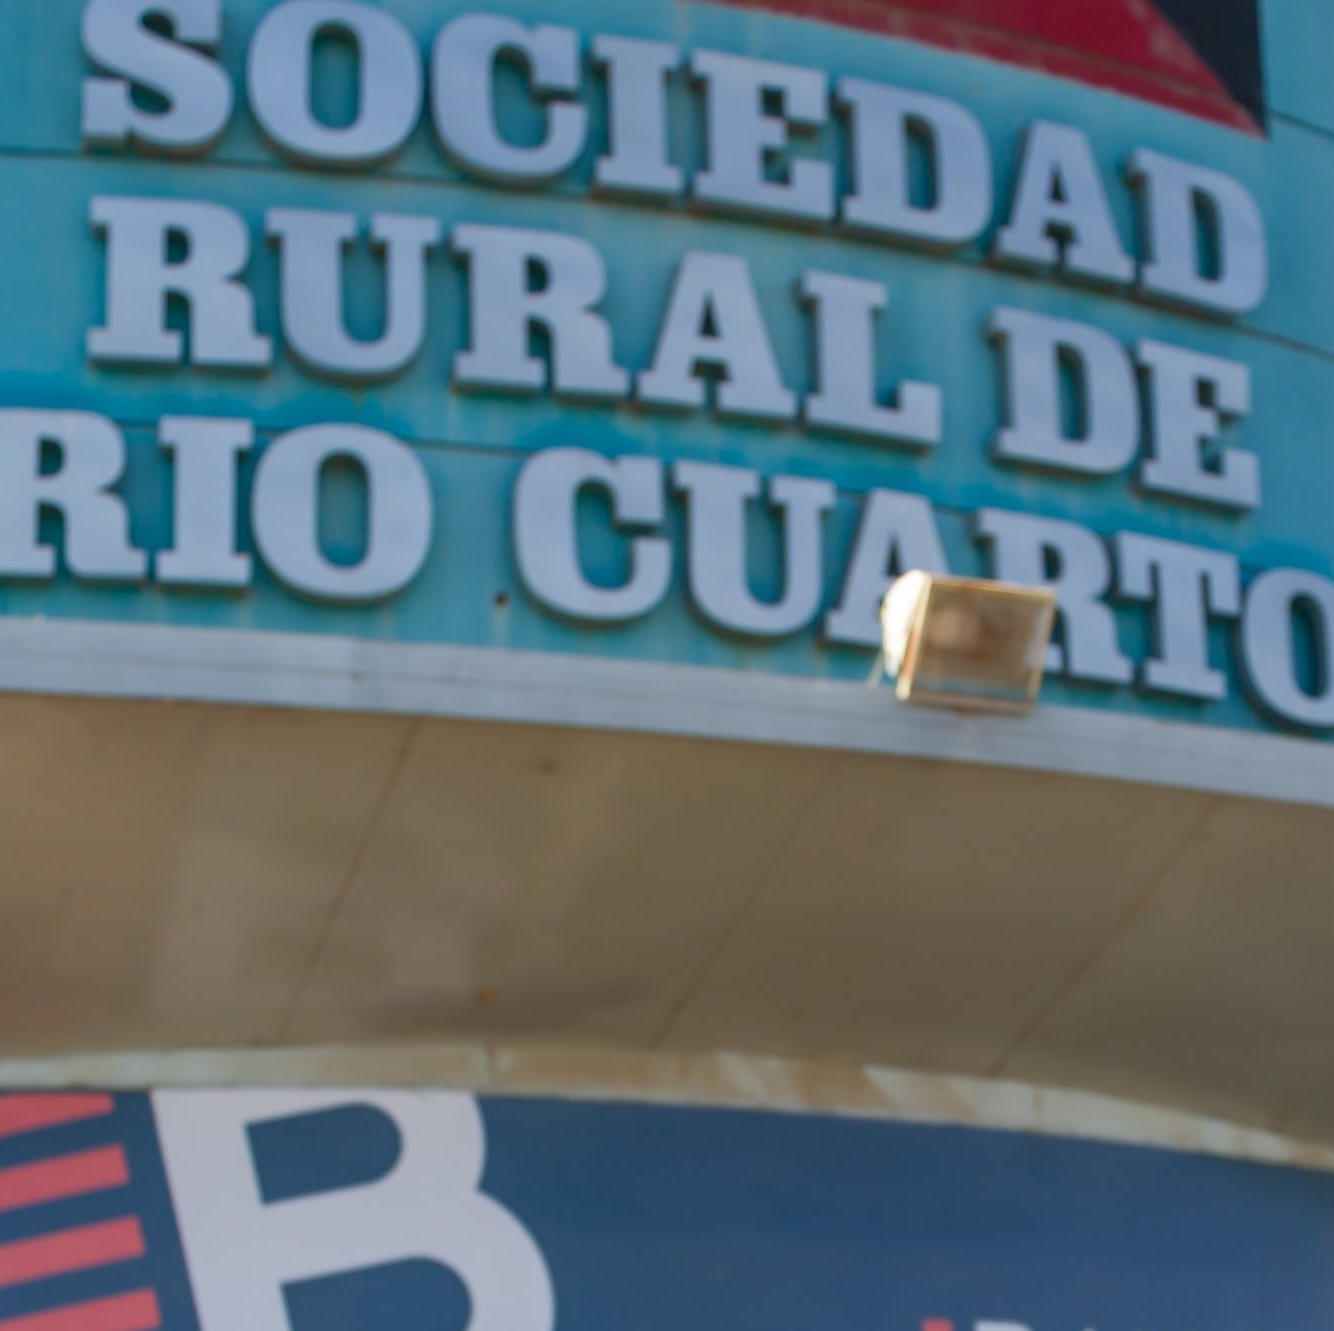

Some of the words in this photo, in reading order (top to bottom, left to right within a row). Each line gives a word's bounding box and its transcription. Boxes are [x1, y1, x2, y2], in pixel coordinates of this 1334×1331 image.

[81, 0, 1267, 318] SOCIEDAD
[87, 196, 940, 450] RURAL
[989, 306, 1262, 514] DE
